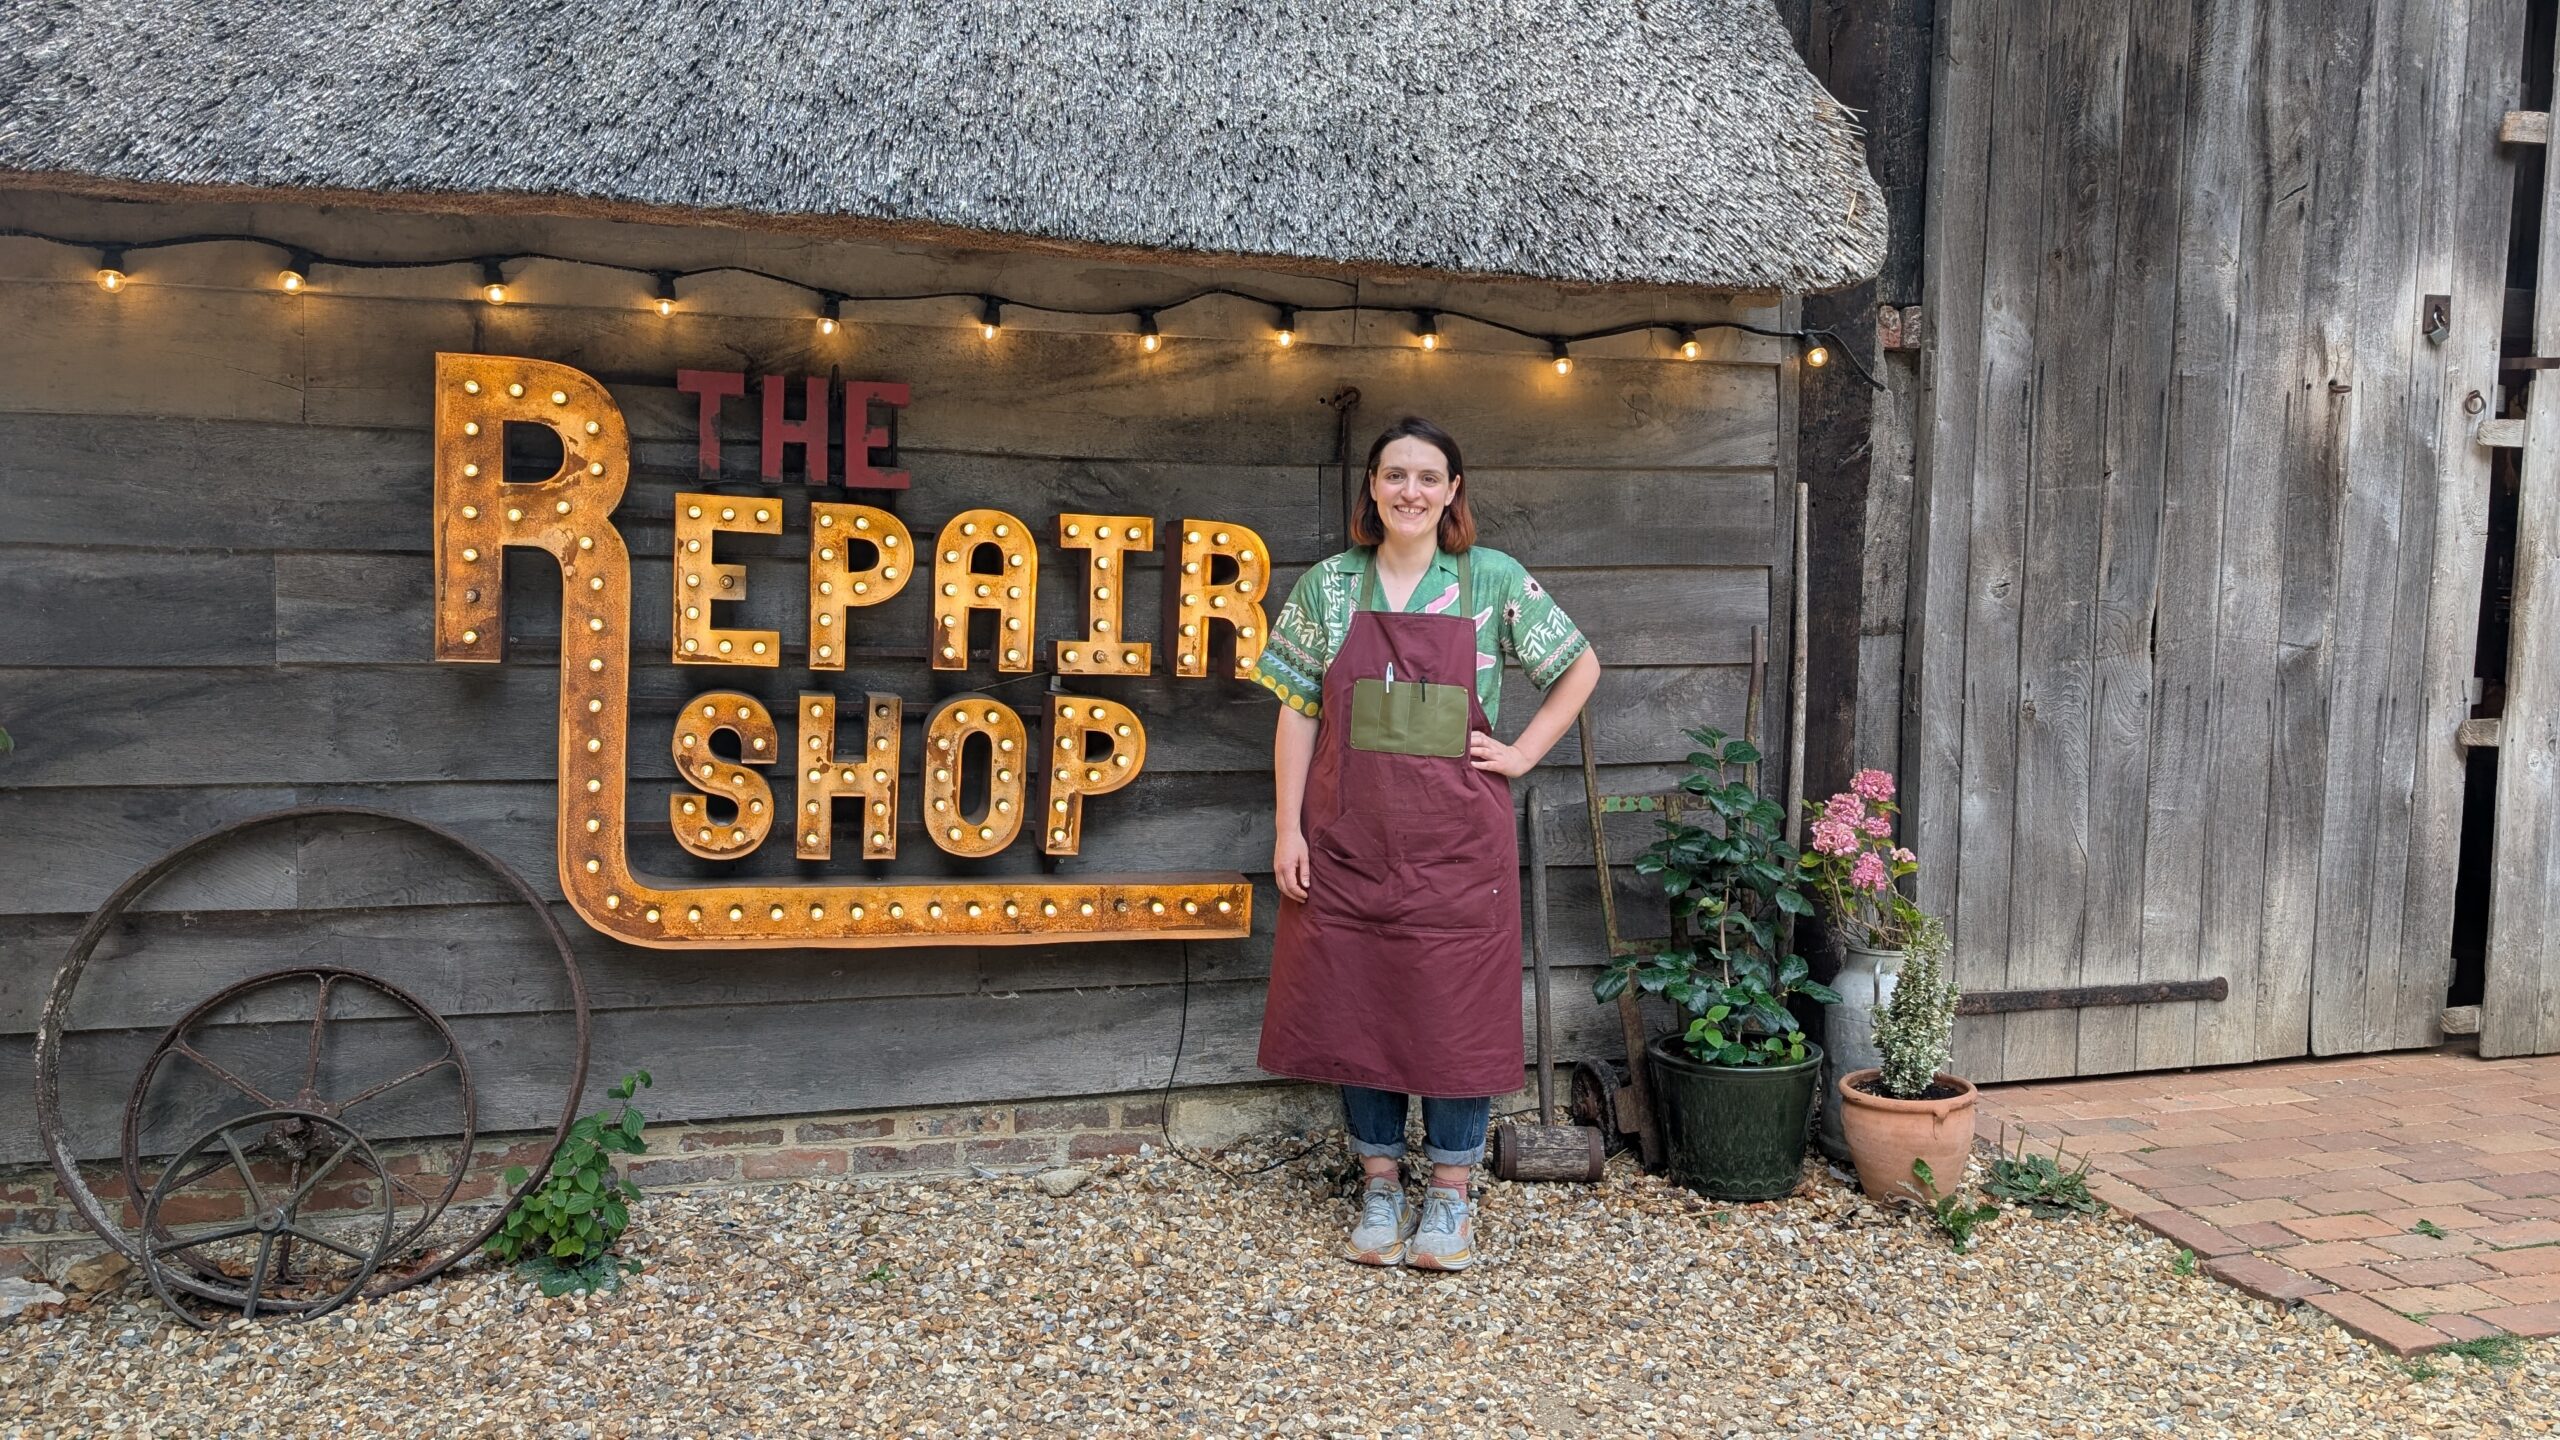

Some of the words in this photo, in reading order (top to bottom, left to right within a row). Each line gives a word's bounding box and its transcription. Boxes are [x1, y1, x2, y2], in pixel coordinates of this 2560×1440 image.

[677, 369, 911, 490] THE
[434, 352, 1271, 949] REPAIR
[670, 690, 1147, 861] SHOP
